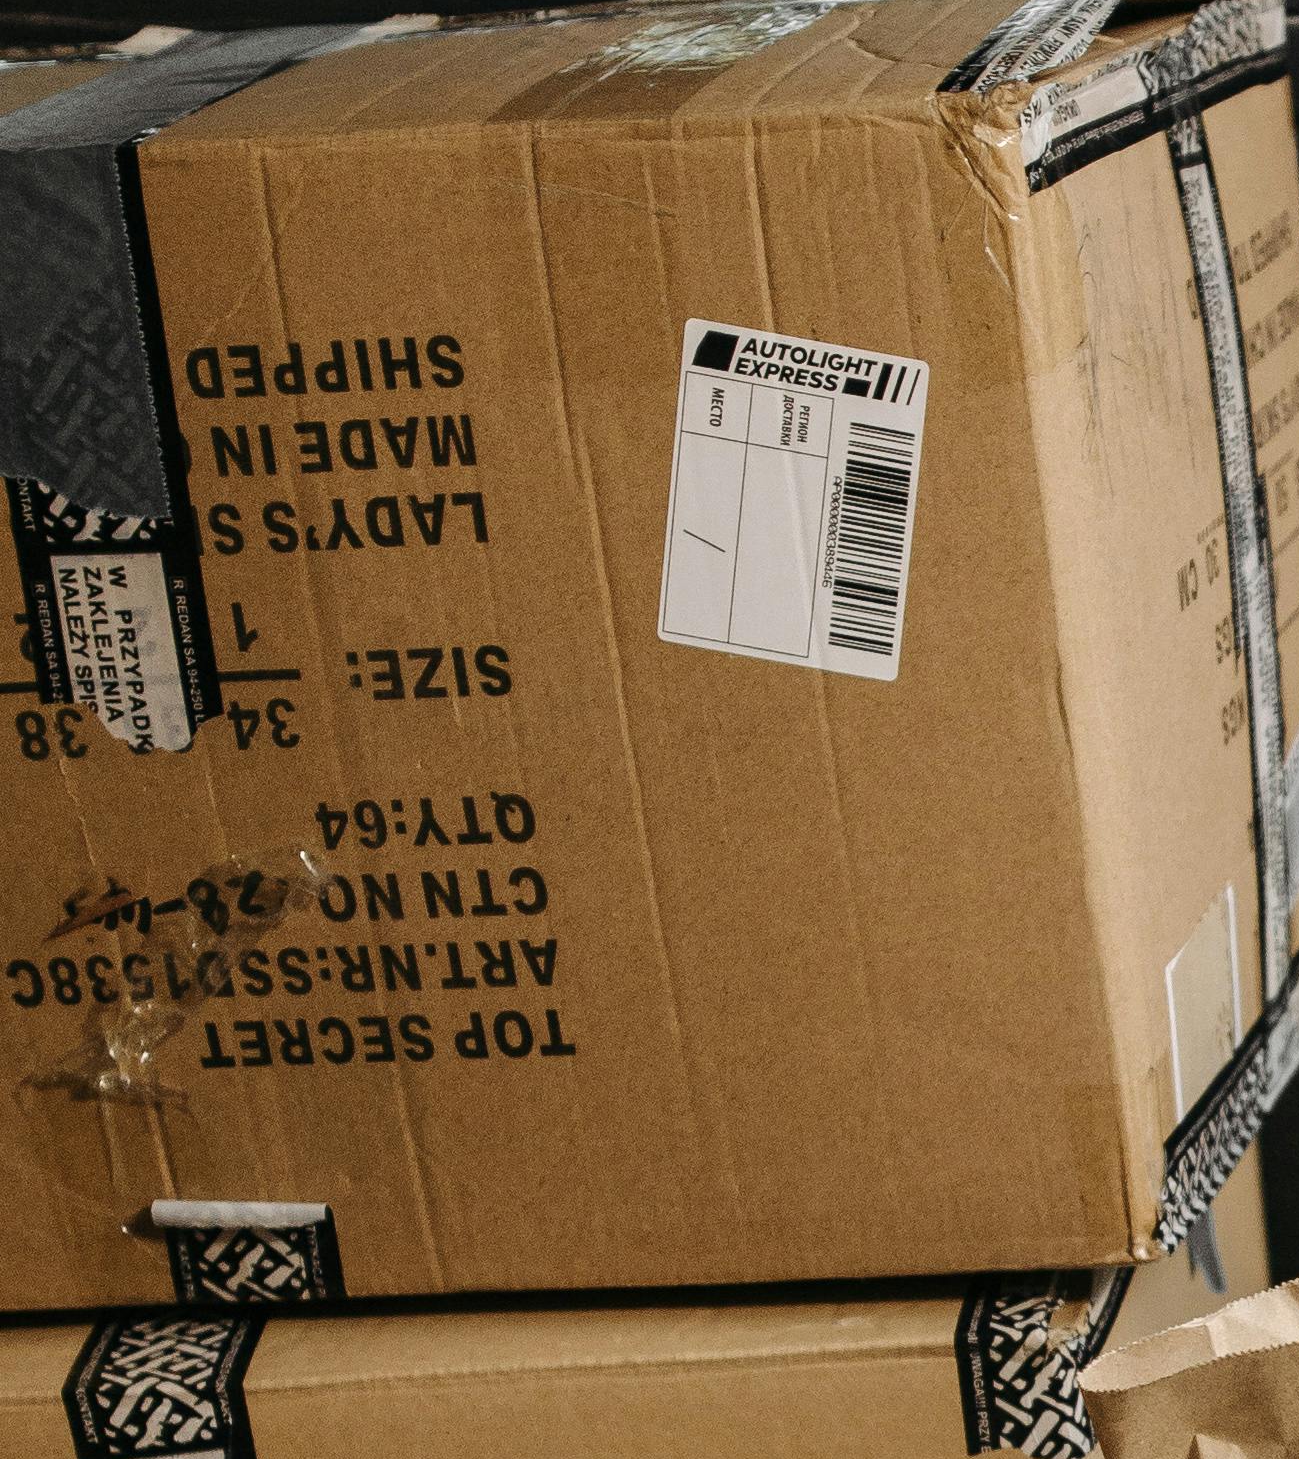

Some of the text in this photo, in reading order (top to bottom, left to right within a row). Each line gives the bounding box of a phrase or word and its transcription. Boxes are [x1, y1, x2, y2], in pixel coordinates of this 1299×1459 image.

[186, 336, 464, 399] SHIPPED
[734, 357, 839, 392] EXPRESS
[741, 337, 878, 377] AUTOLIGHT
[708, 387, 726, 428] МЕСТО
[779, 394, 796, 447] ДОСТАВКИ
[797, 405, 811, 444] РЕГИОН
[211, 415, 476, 476] MADE IN
[186, 492, 488, 553] LADY'S S
[108, 565, 126, 587] W
[1177, 557, 1200, 613] CM
[36, 600, 54, 647] REDAN
[45, 651, 58, 669] SA
[58, 567, 88, 657] NALEŻY
[174, 595, 192, 643] REDAN
[183, 647, 195, 665] SA
[231, 603, 258, 652] 1
[82, 566, 123, 721] ZAKLEJENIA
[346, 645, 512, 700] SIZE:
[15, 699, 299, 761] 34 38
[315, 792, 535, 850] QTY:64
[421, 867, 548, 918] CTN
[201, 1010, 576, 1069] TOP SECRET
